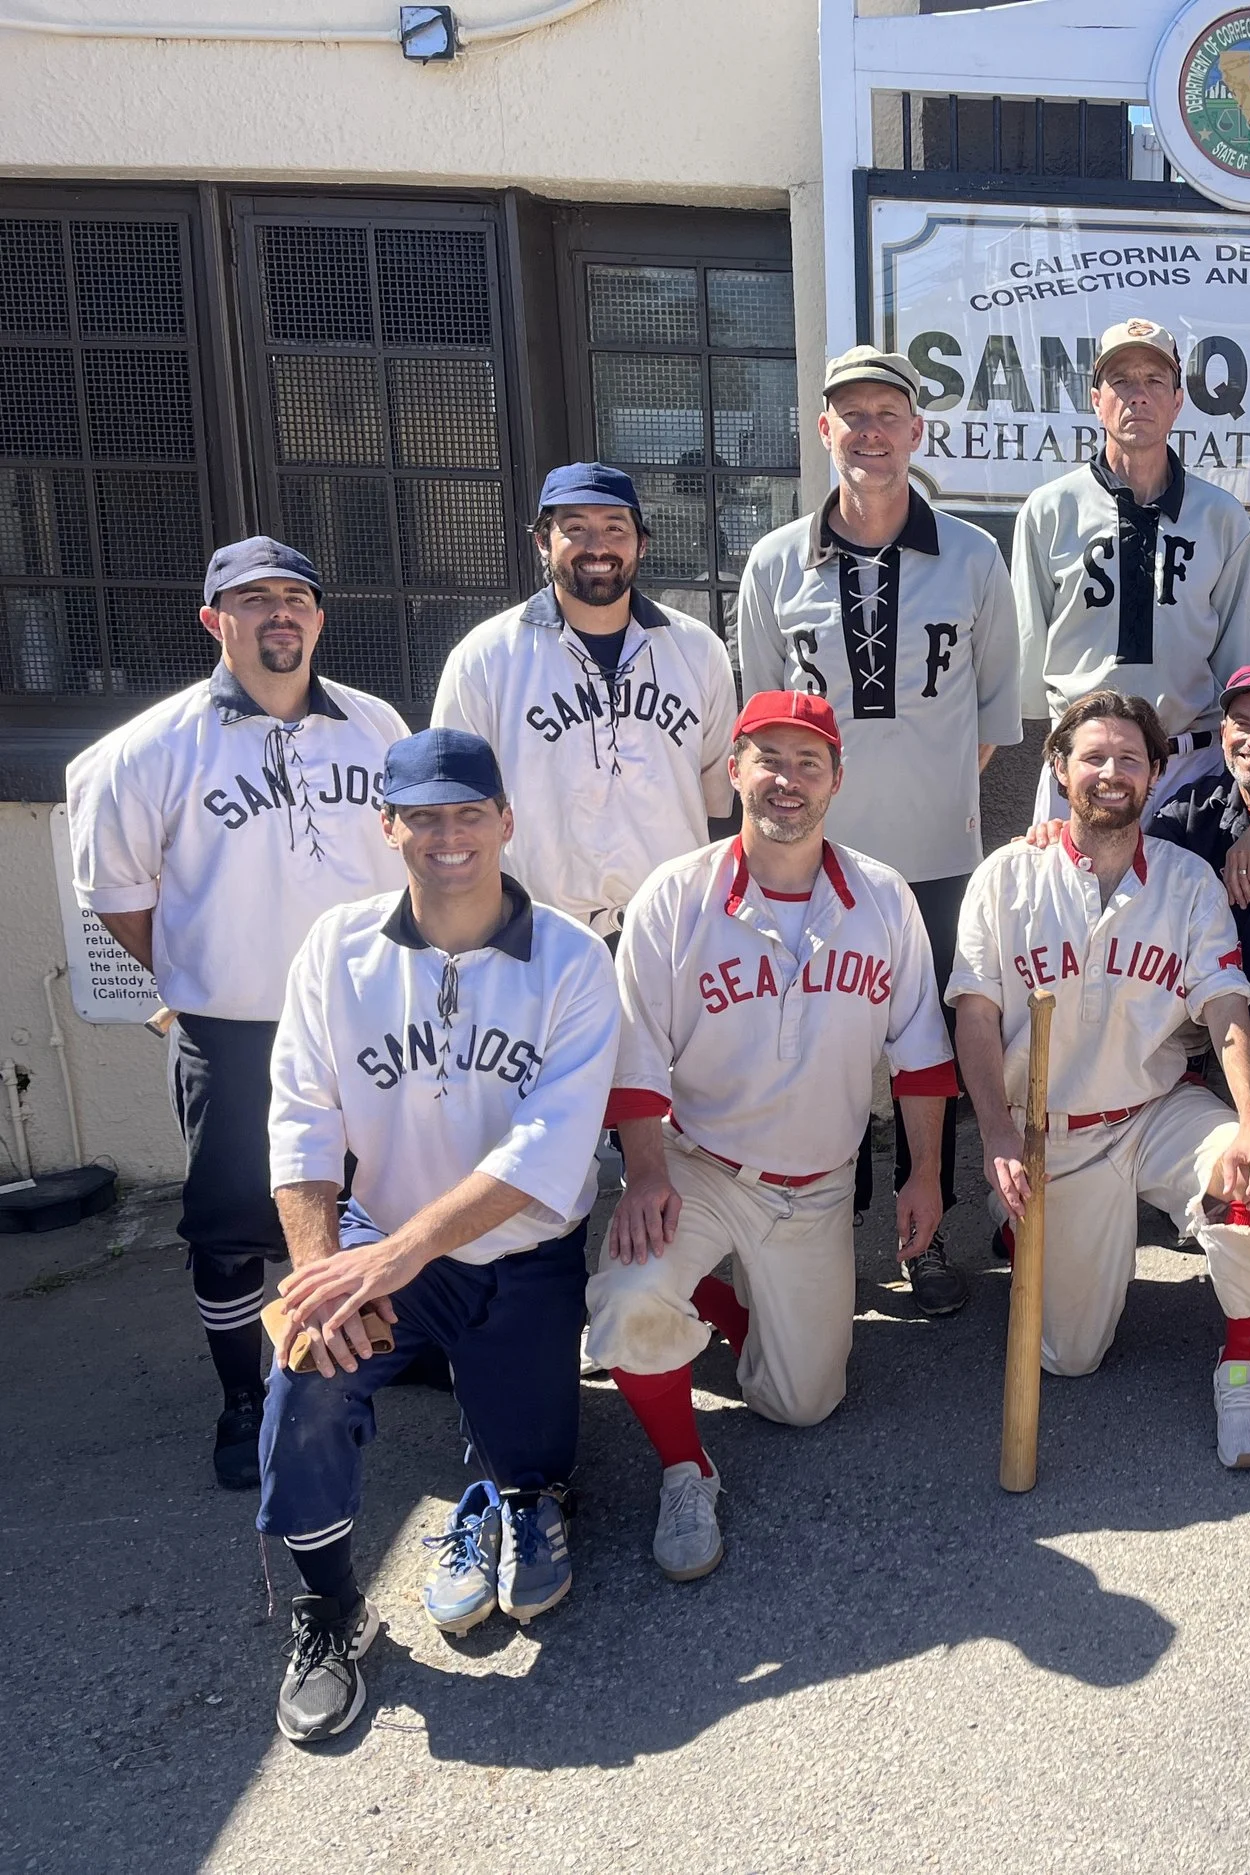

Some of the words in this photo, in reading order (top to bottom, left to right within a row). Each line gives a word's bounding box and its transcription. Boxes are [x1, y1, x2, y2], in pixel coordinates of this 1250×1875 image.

[1185, 50, 1213, 113] DEPARTMENT
[1204, 37, 1221, 56] OF
[1212, 142, 1234, 166] STATE
[1236, 155, 1248, 170] OF
[970, 267, 1191, 311] CORRECTIONS
[1010, 245, 1200, 278] CALIFORNIA
[907, 331, 1096, 414] SAN
[1083, 536, 1115, 609] S
[1157, 534, 1196, 605] F
[921, 622, 958, 698] F
[526, 681, 603, 742] SAN
[612, 679, 700, 747] JOSE
[204, 763, 296, 829] SAN
[319, 763, 385, 812] JOS
[90, 962, 111, 972] the
[92, 976, 144, 987] custody
[699, 955, 778, 1014] SEA
[803, 950, 891, 1005] LIONS
[1014, 941, 1080, 989] SEA
[357, 1021, 437, 1090] SAN
